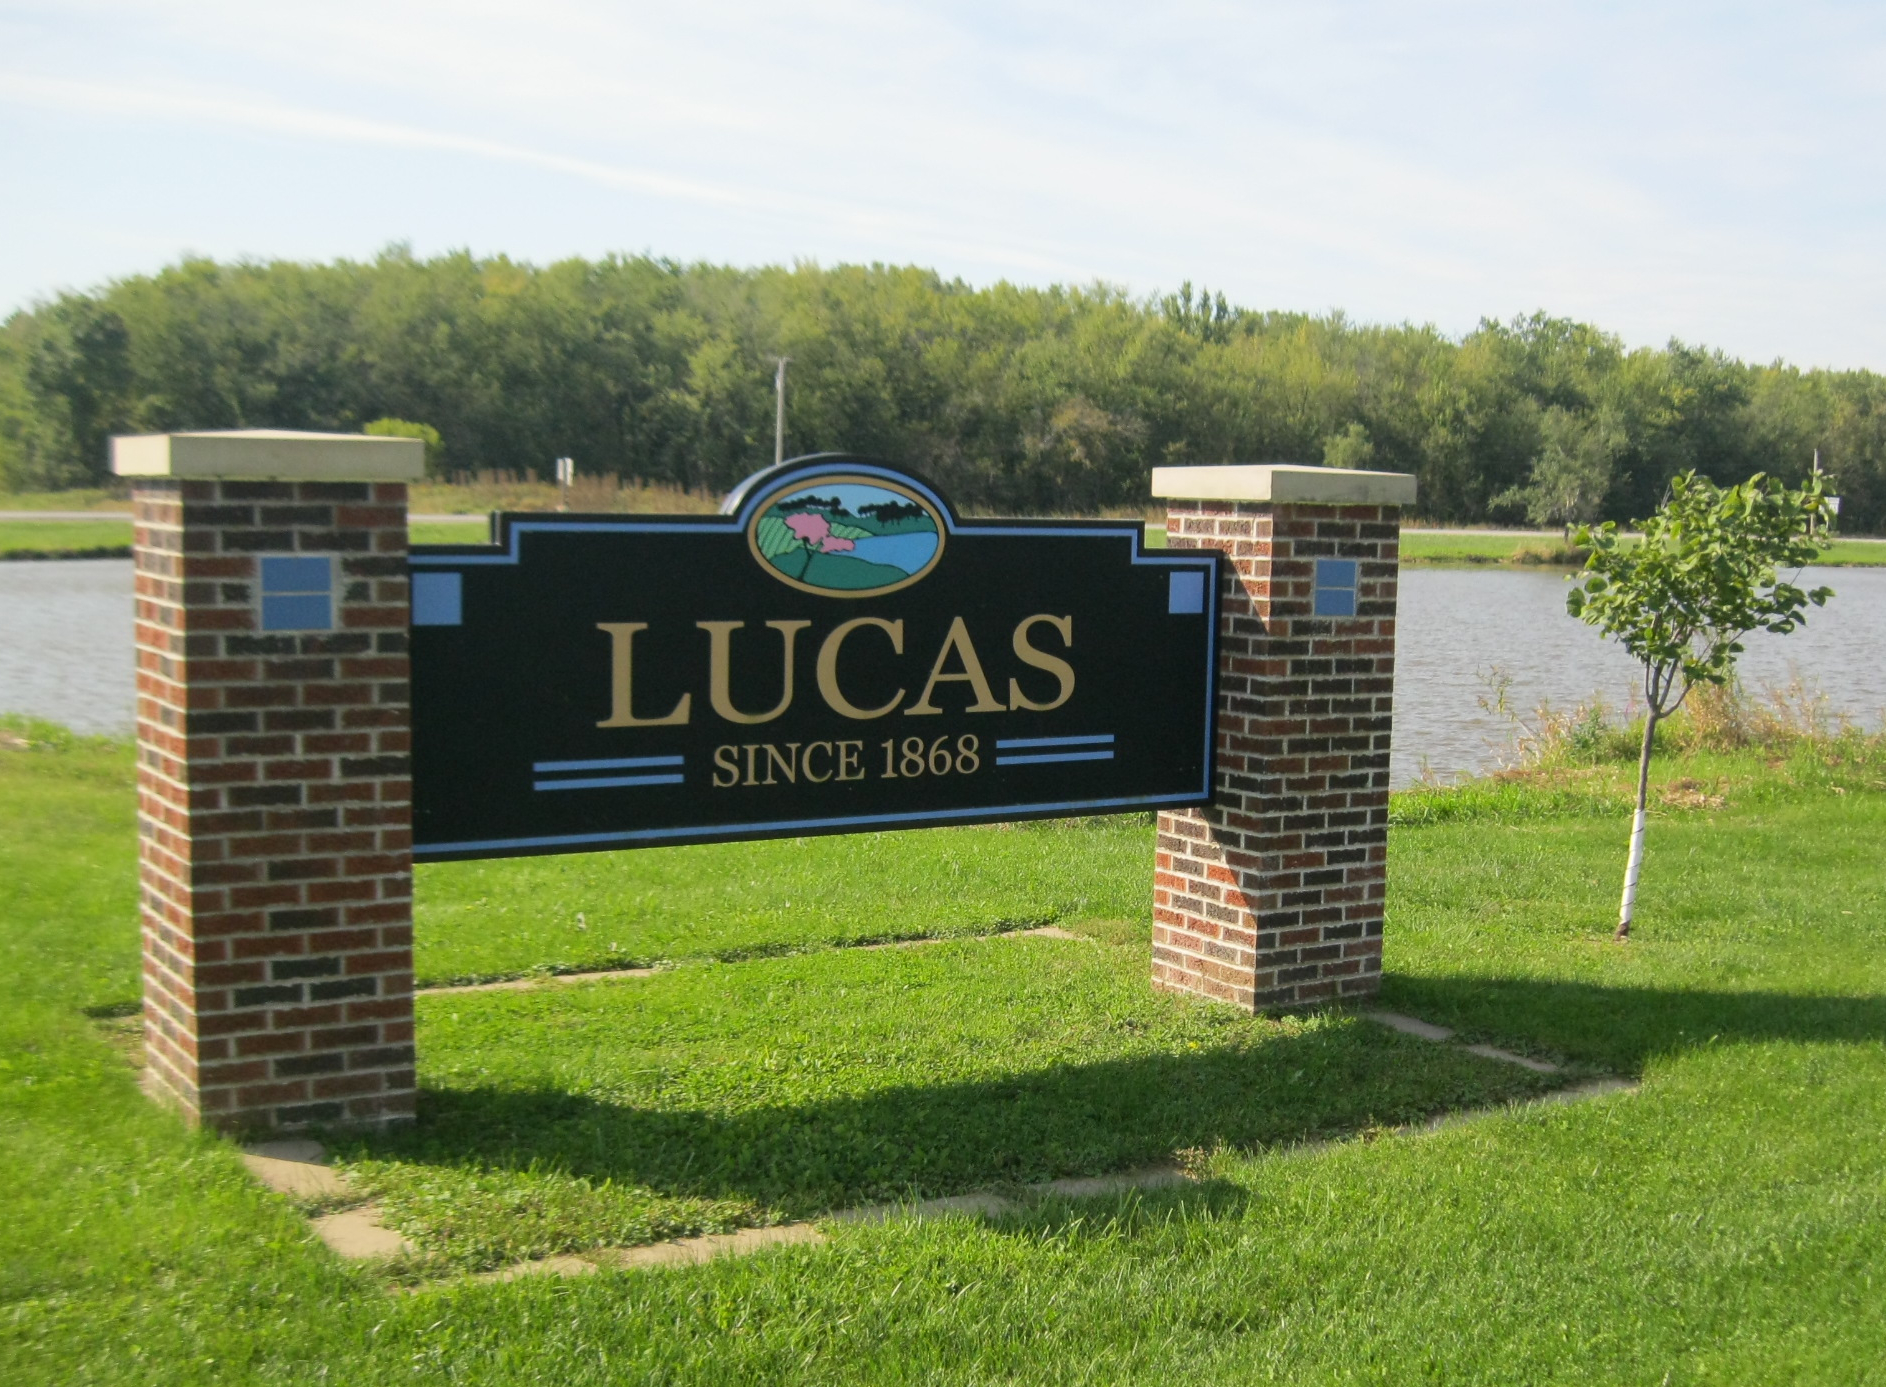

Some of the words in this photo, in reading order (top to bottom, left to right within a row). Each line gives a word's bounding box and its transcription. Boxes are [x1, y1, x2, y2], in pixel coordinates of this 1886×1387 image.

[596, 613, 1076, 728] LUCAS
[712, 740, 865, 788] SINCE
[881, 734, 980, 779] 1868
